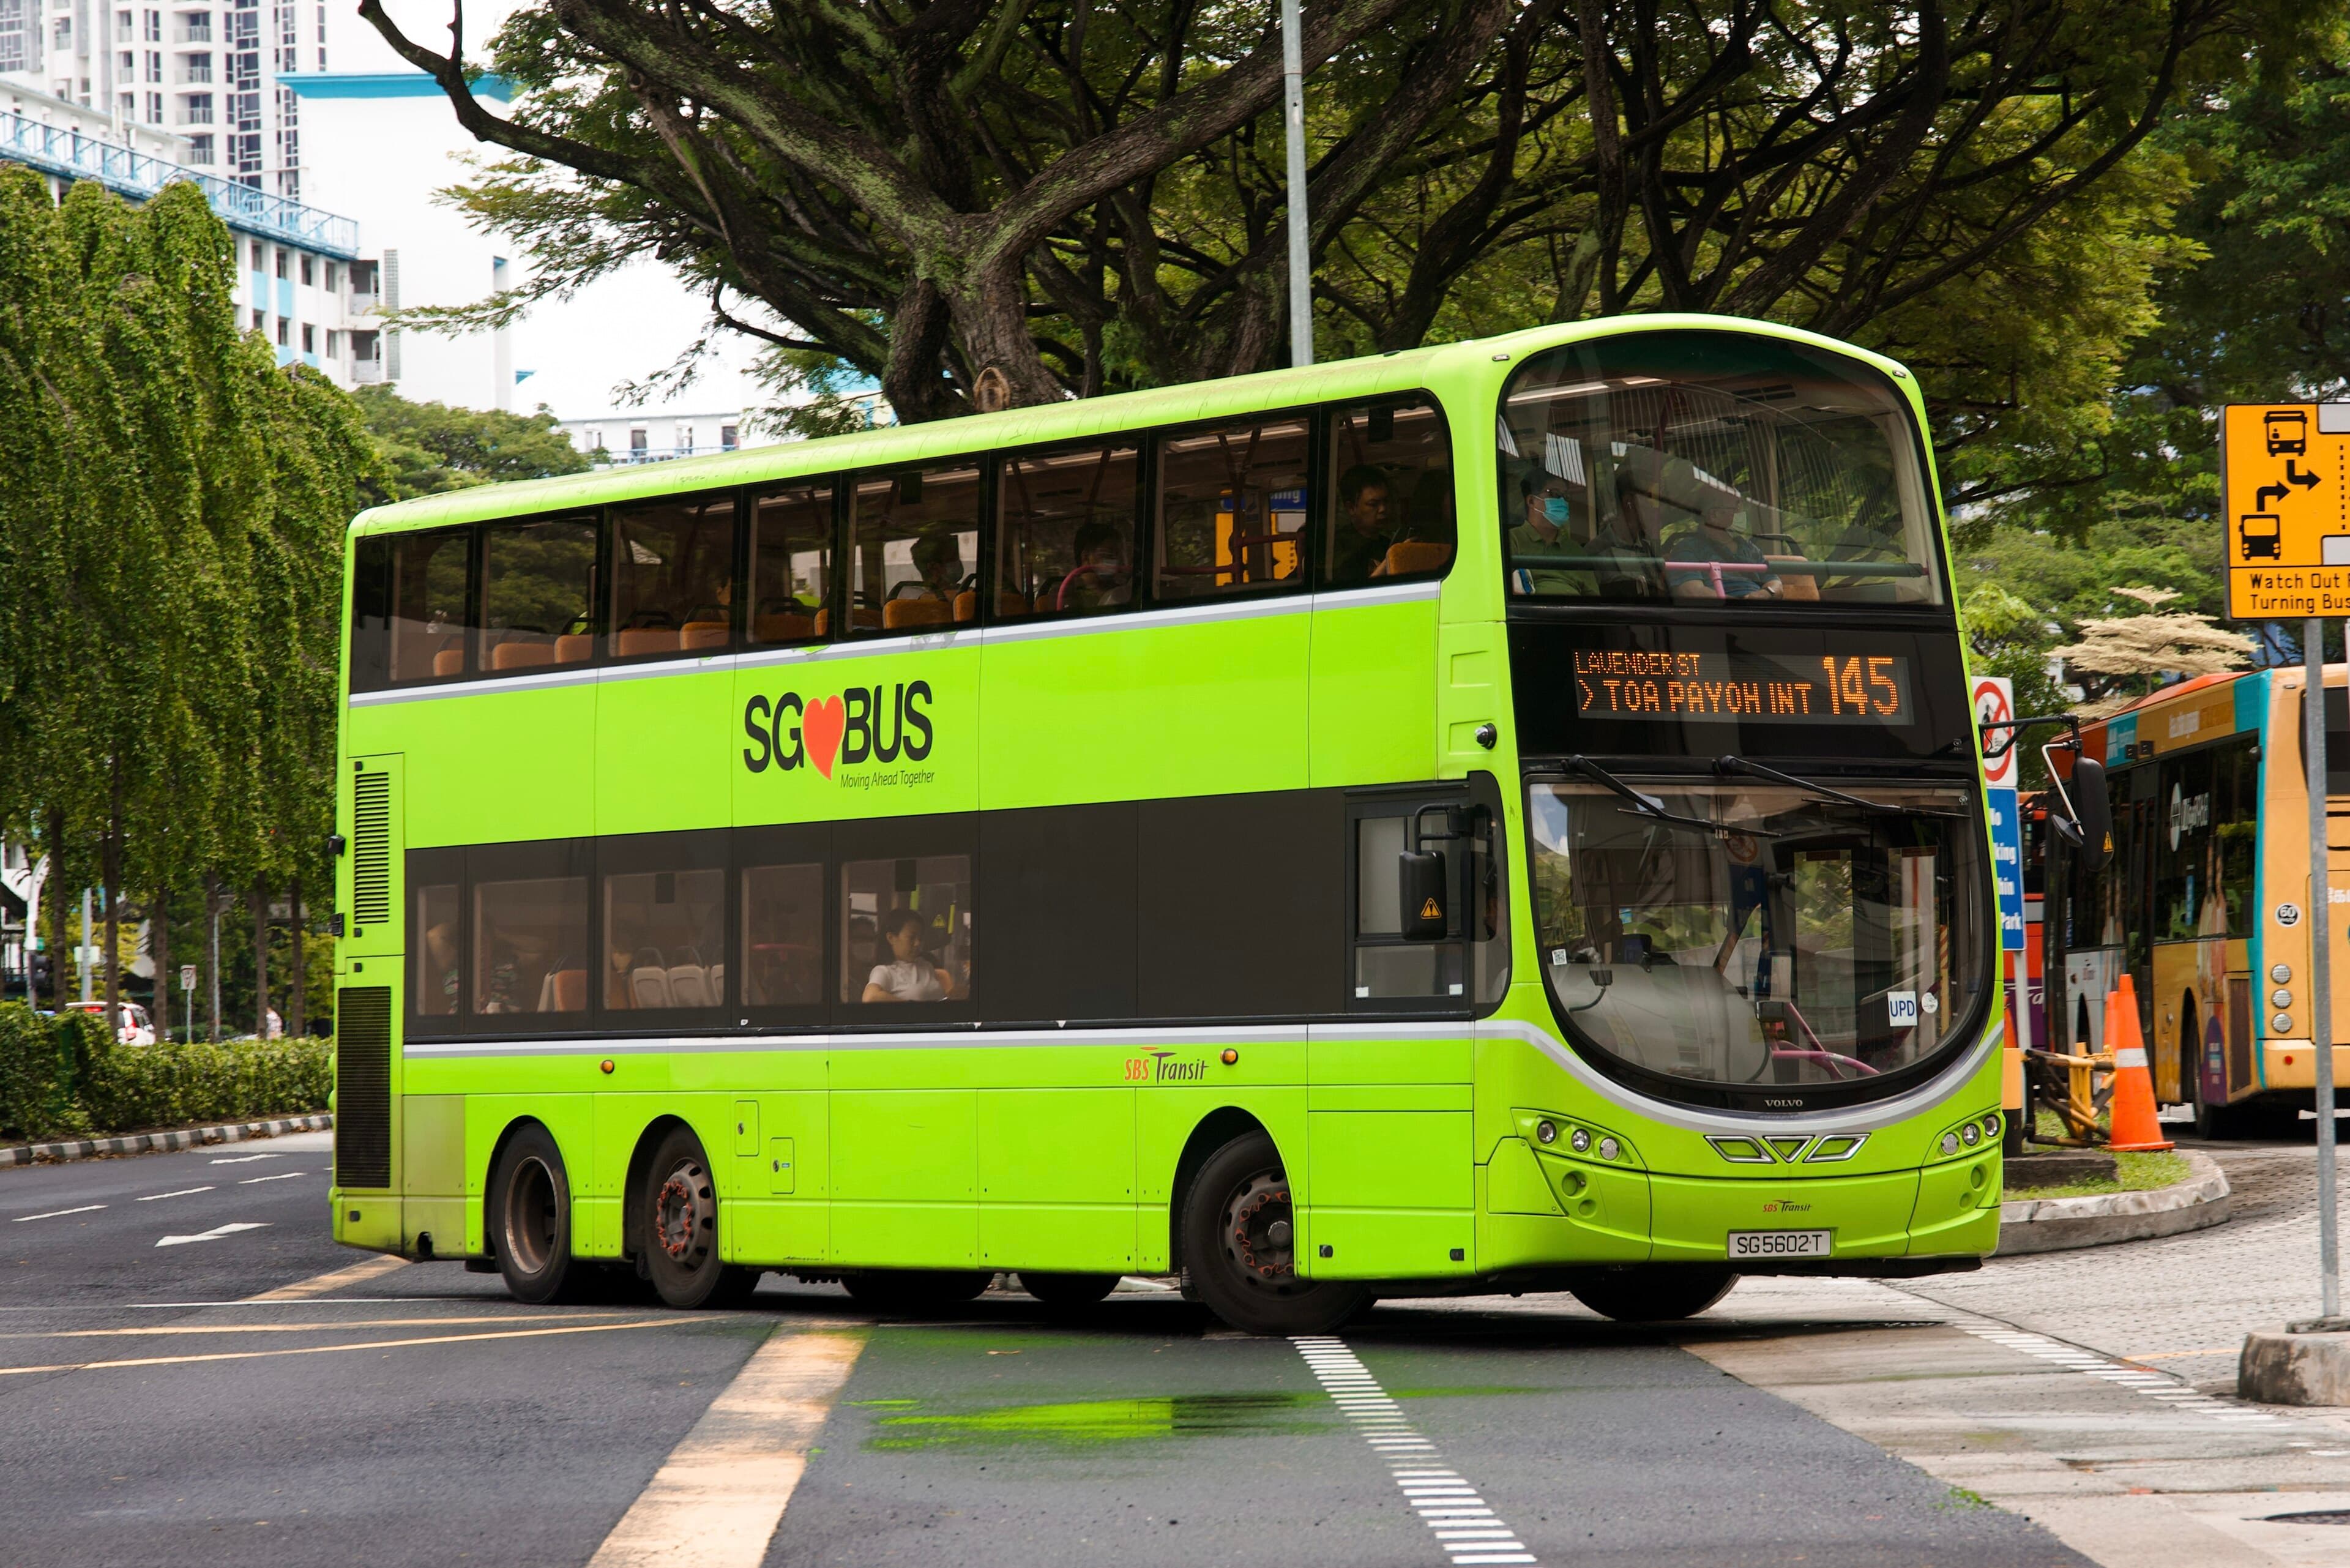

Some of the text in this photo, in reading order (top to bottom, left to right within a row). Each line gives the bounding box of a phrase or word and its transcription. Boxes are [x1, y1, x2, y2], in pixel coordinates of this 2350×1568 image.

[2250, 573, 2340, 589] Watch Out
[2250, 594, 2315, 613] Turning
[1575, 652, 1701, 676] LAVENDER ST
[1822, 656, 1898, 715] 145
[1603, 680, 1812, 715] TOA PAYOH INT
[840, 769, 935, 790] Moving Ahead Together
[2279, 906, 2297, 917] 60
[1890, 1000, 1915, 1017] UPD
[1125, 1052, 1209, 1085] SBS Transit
[1763, 1201, 1813, 1213] SBS Transit
[1737, 1234, 1822, 1253] SG5602T
